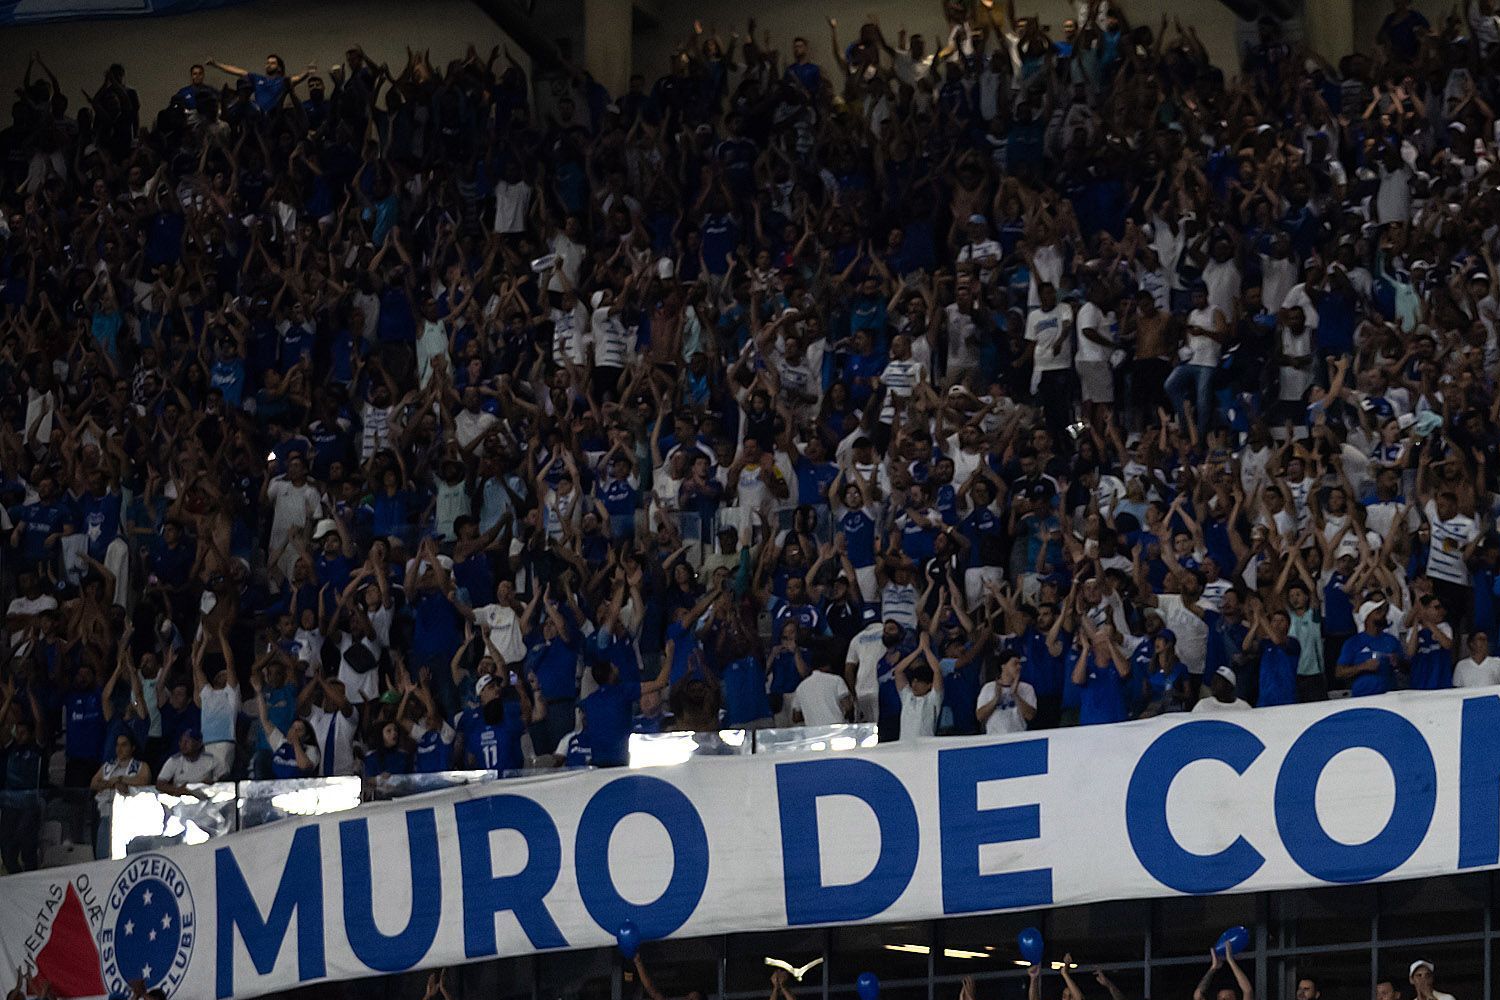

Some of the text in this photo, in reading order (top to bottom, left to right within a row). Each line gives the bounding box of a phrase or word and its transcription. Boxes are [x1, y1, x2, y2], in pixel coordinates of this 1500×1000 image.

[111, 859, 185, 910] CRUZEIRO
[216, 776, 709, 998] MURO
[775, 738, 1053, 925] DE
